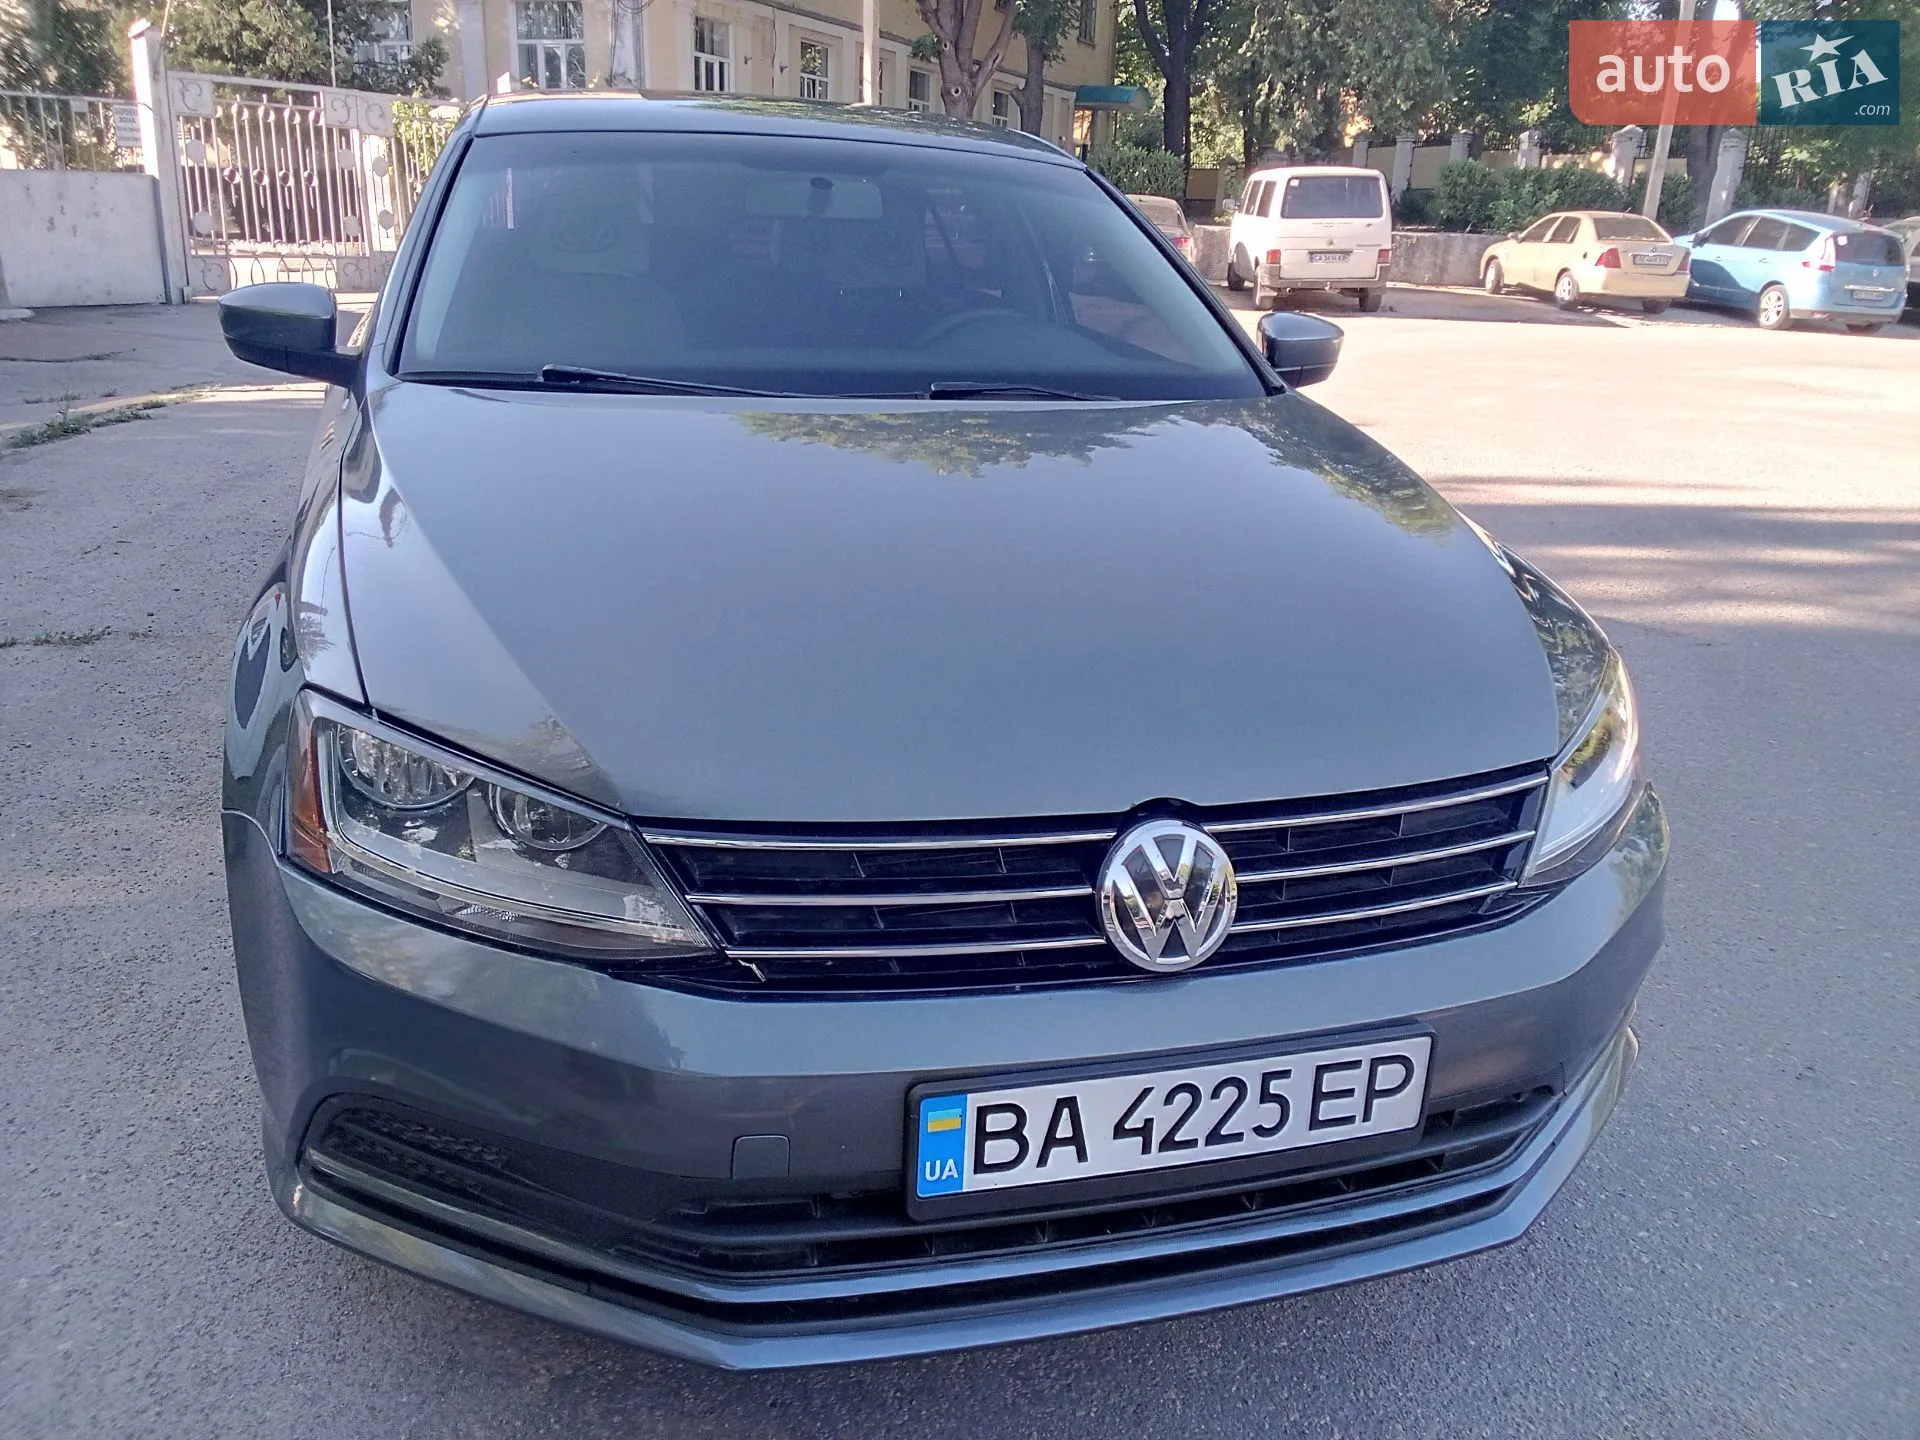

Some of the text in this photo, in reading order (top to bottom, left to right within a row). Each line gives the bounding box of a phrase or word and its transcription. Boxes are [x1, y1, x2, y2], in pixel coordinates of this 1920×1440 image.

[973, 1054, 1415, 1175] BA 4225 EP
[924, 1160, 959, 1182] UA
